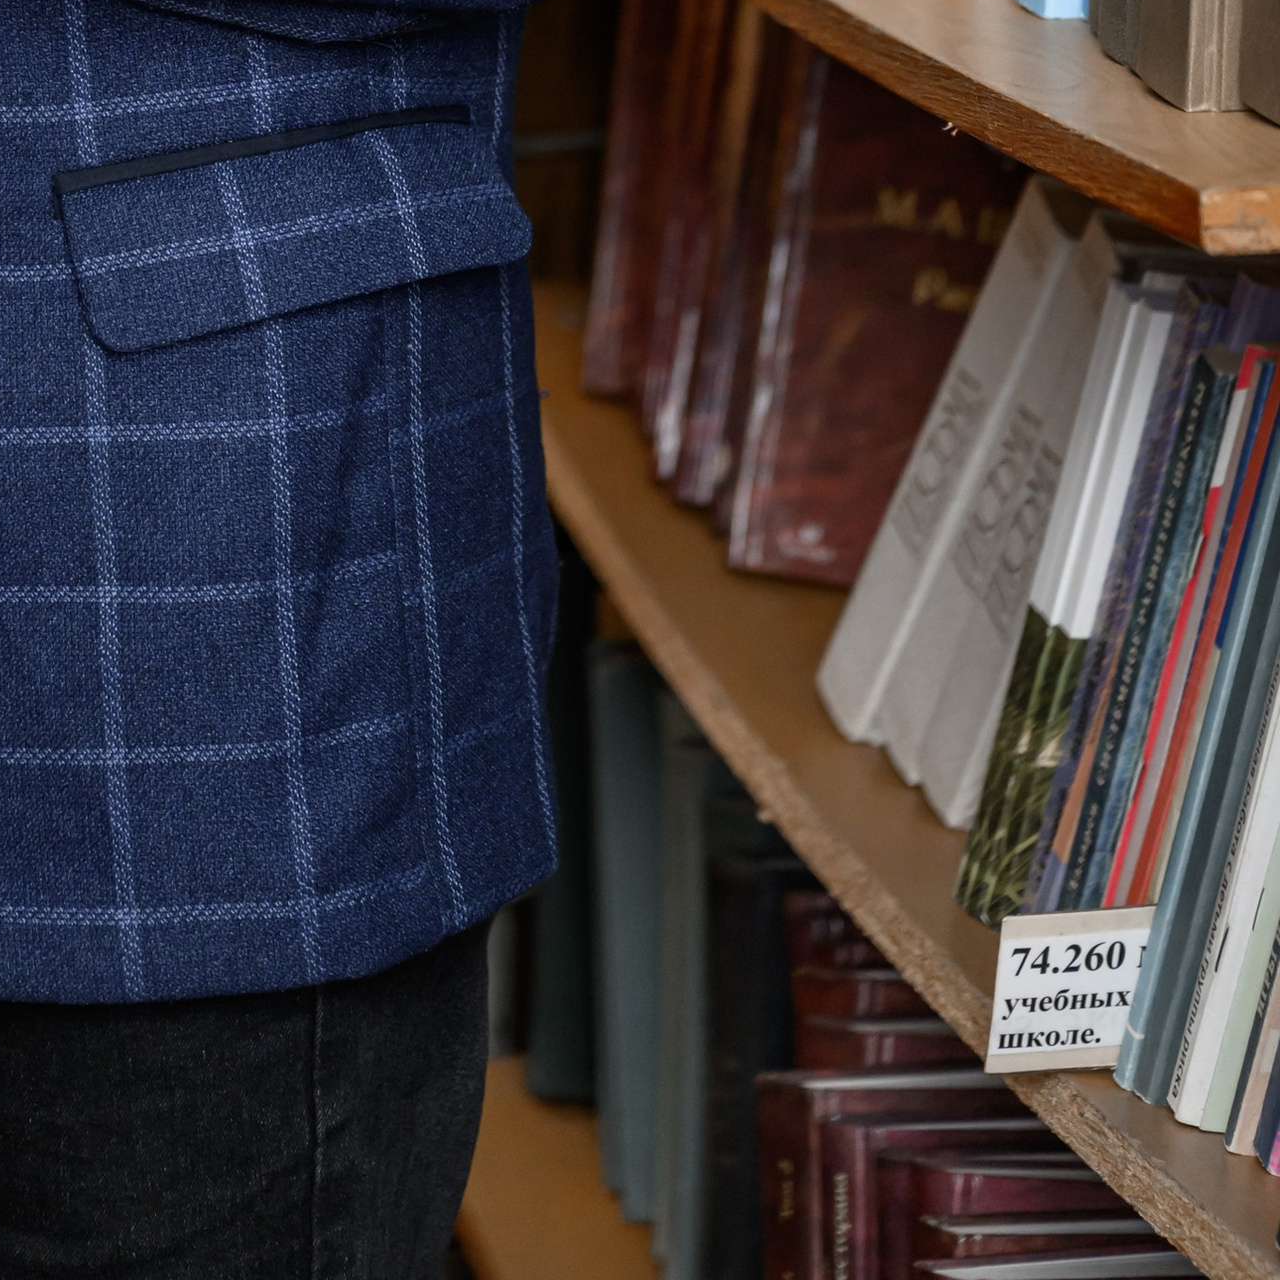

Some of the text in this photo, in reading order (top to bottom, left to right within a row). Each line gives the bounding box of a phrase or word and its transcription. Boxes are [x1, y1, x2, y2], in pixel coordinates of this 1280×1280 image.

[1249, 661, 1280, 777] оциальная
[1230, 782, 1254, 853] работа
[1207, 874, 1231, 953] детьми
[1010, 940, 1127, 978] 74.260
[1001, 988, 1132, 1021] учебных
[1186, 954, 1213, 1035] группы
[997, 1026, 1102, 1050] школе.
[1169, 1036, 1192, 1099] риска
